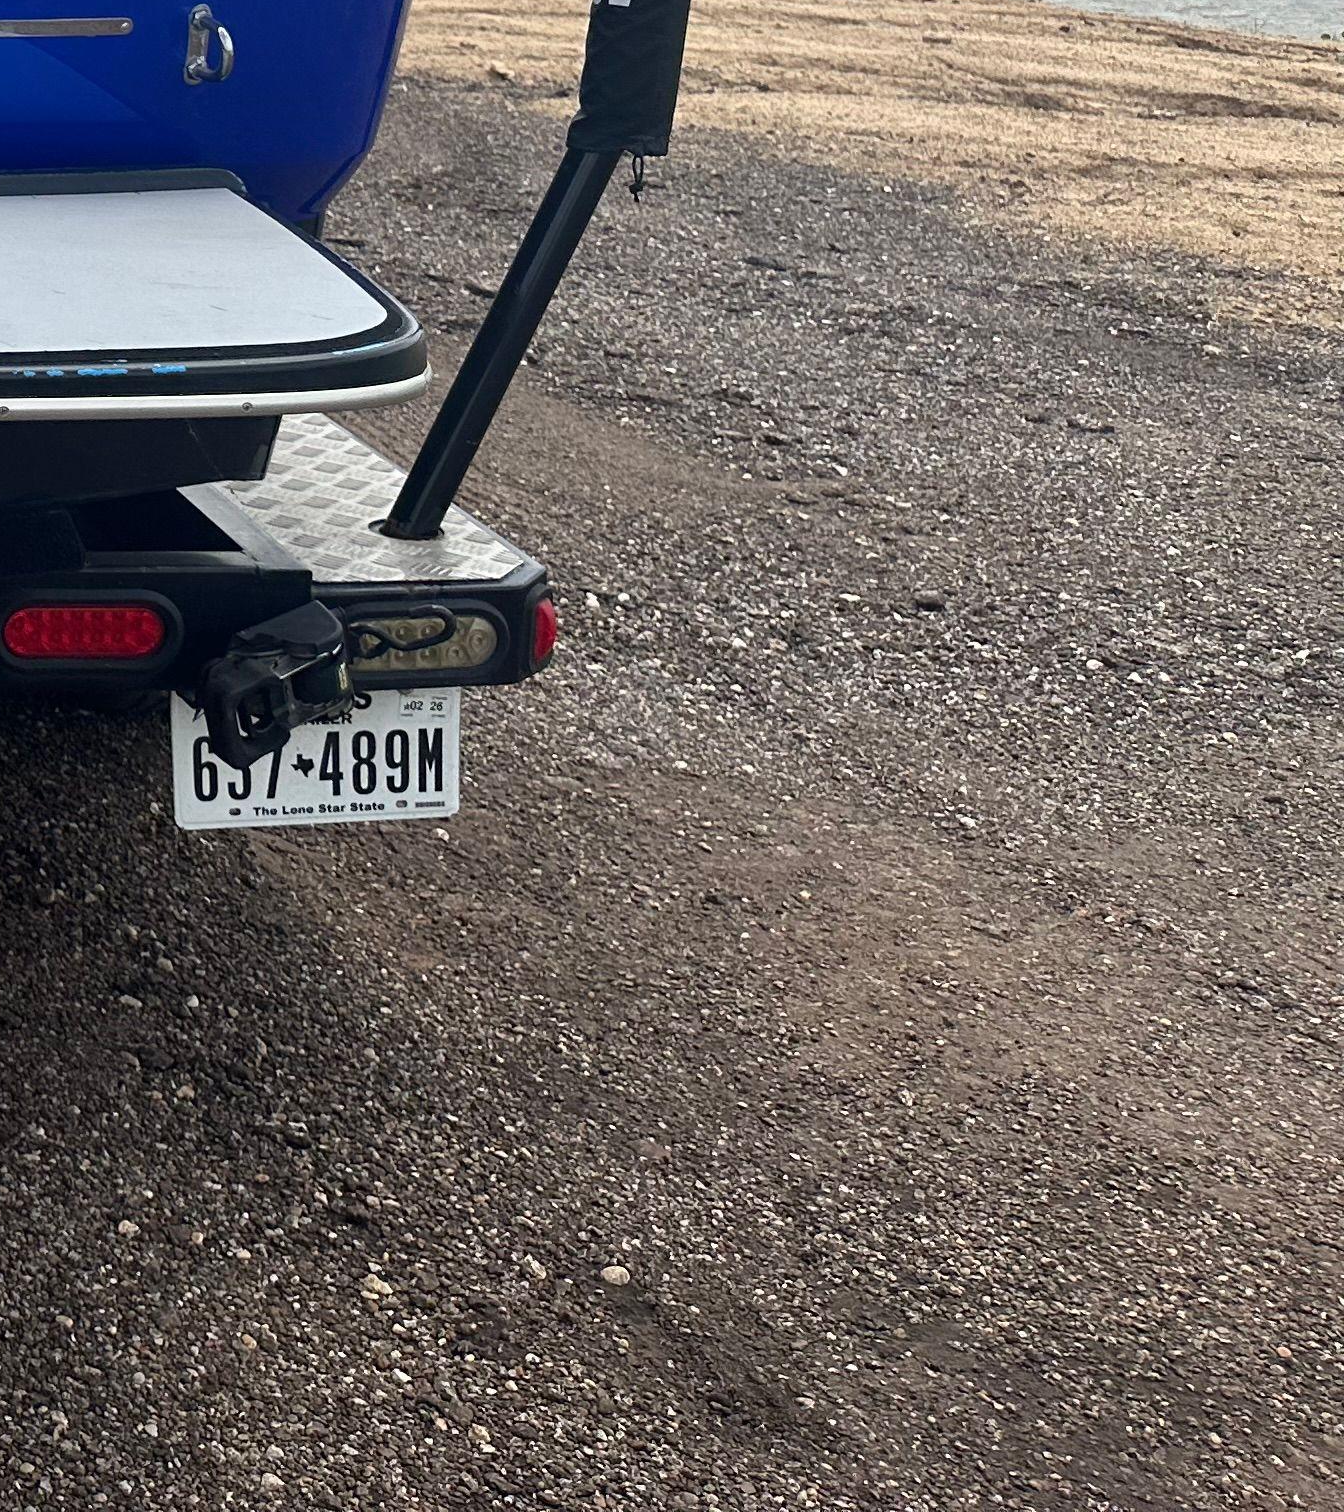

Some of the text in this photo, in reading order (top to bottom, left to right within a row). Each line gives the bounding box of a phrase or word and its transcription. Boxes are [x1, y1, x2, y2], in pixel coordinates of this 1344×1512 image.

[253, 802, 385, 816] The Lone Star State
